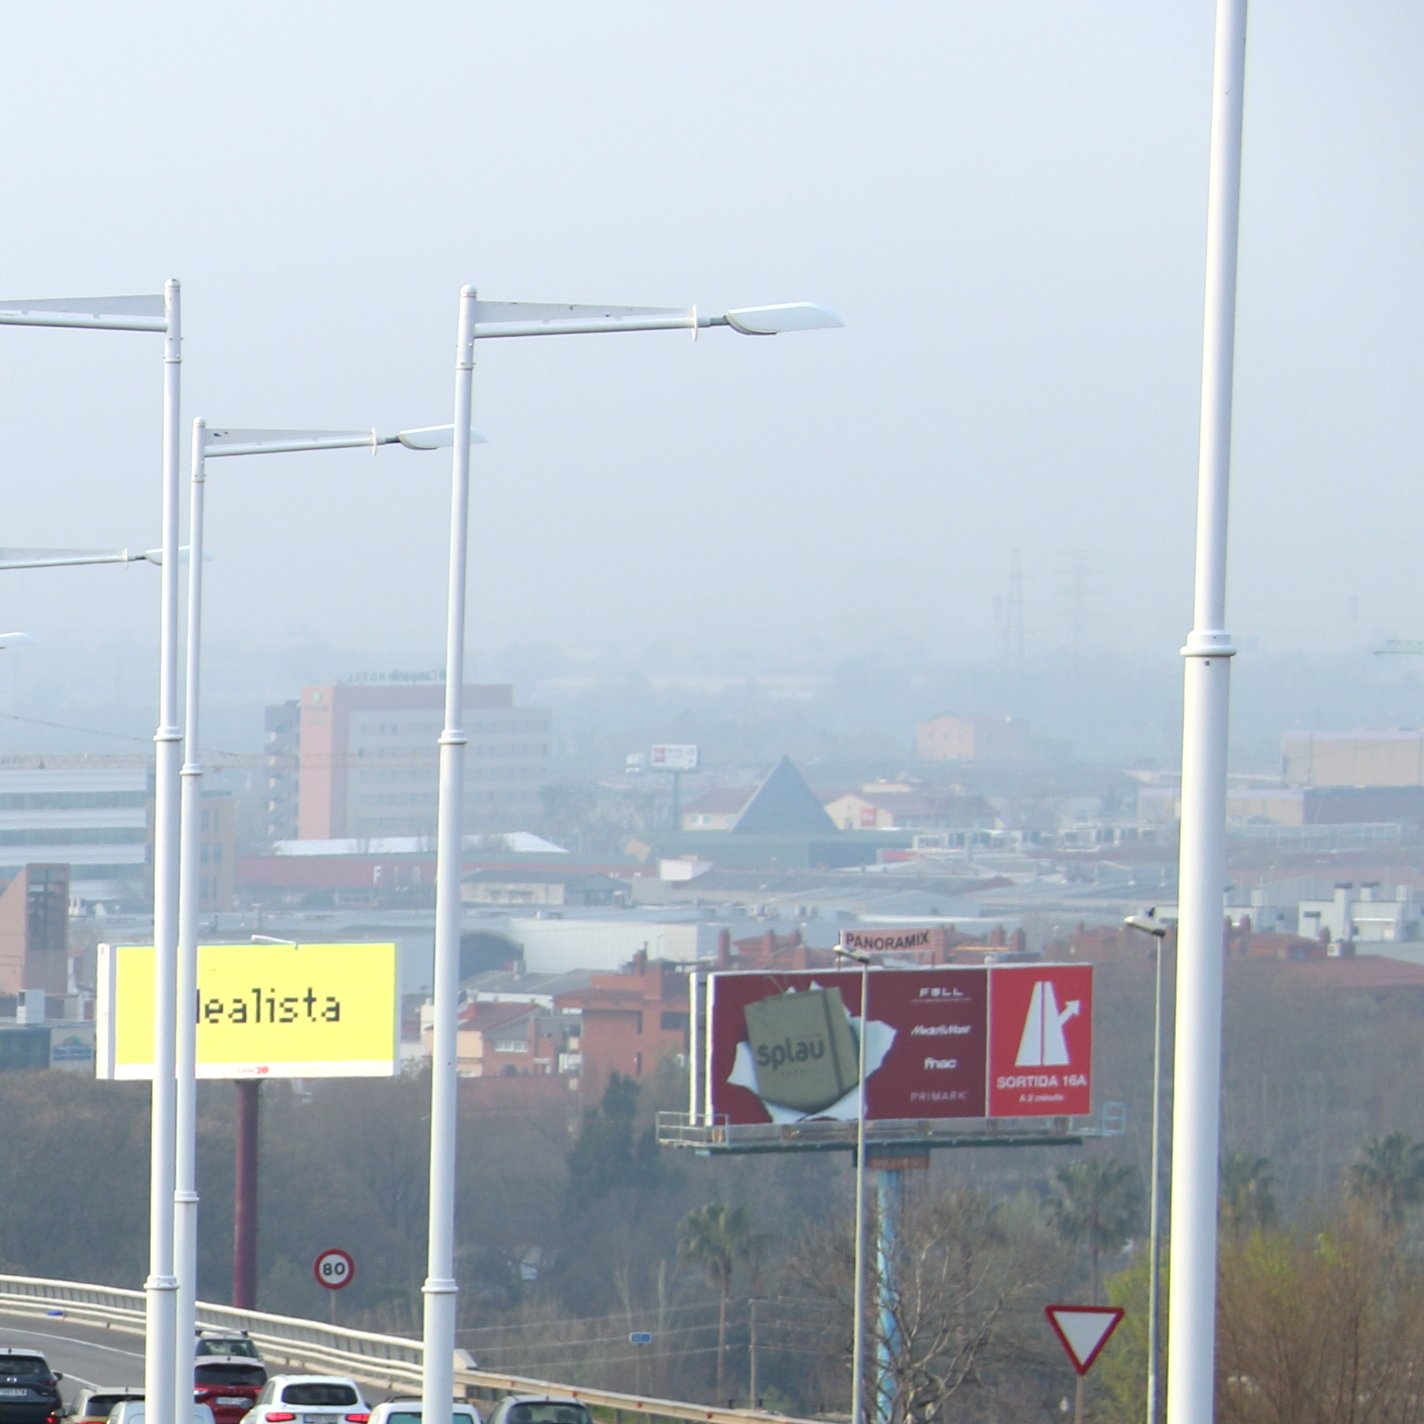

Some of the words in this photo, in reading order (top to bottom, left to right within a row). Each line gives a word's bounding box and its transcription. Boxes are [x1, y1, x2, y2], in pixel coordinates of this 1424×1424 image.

[846, 932, 929, 950] PANORAMIX
[757, 1037, 826, 1071] splau
[997, 1076, 1057, 1088] SORTIDA
[1063, 1074, 1087, 1087] 16A
[323, 1262, 346, 1276] 80
